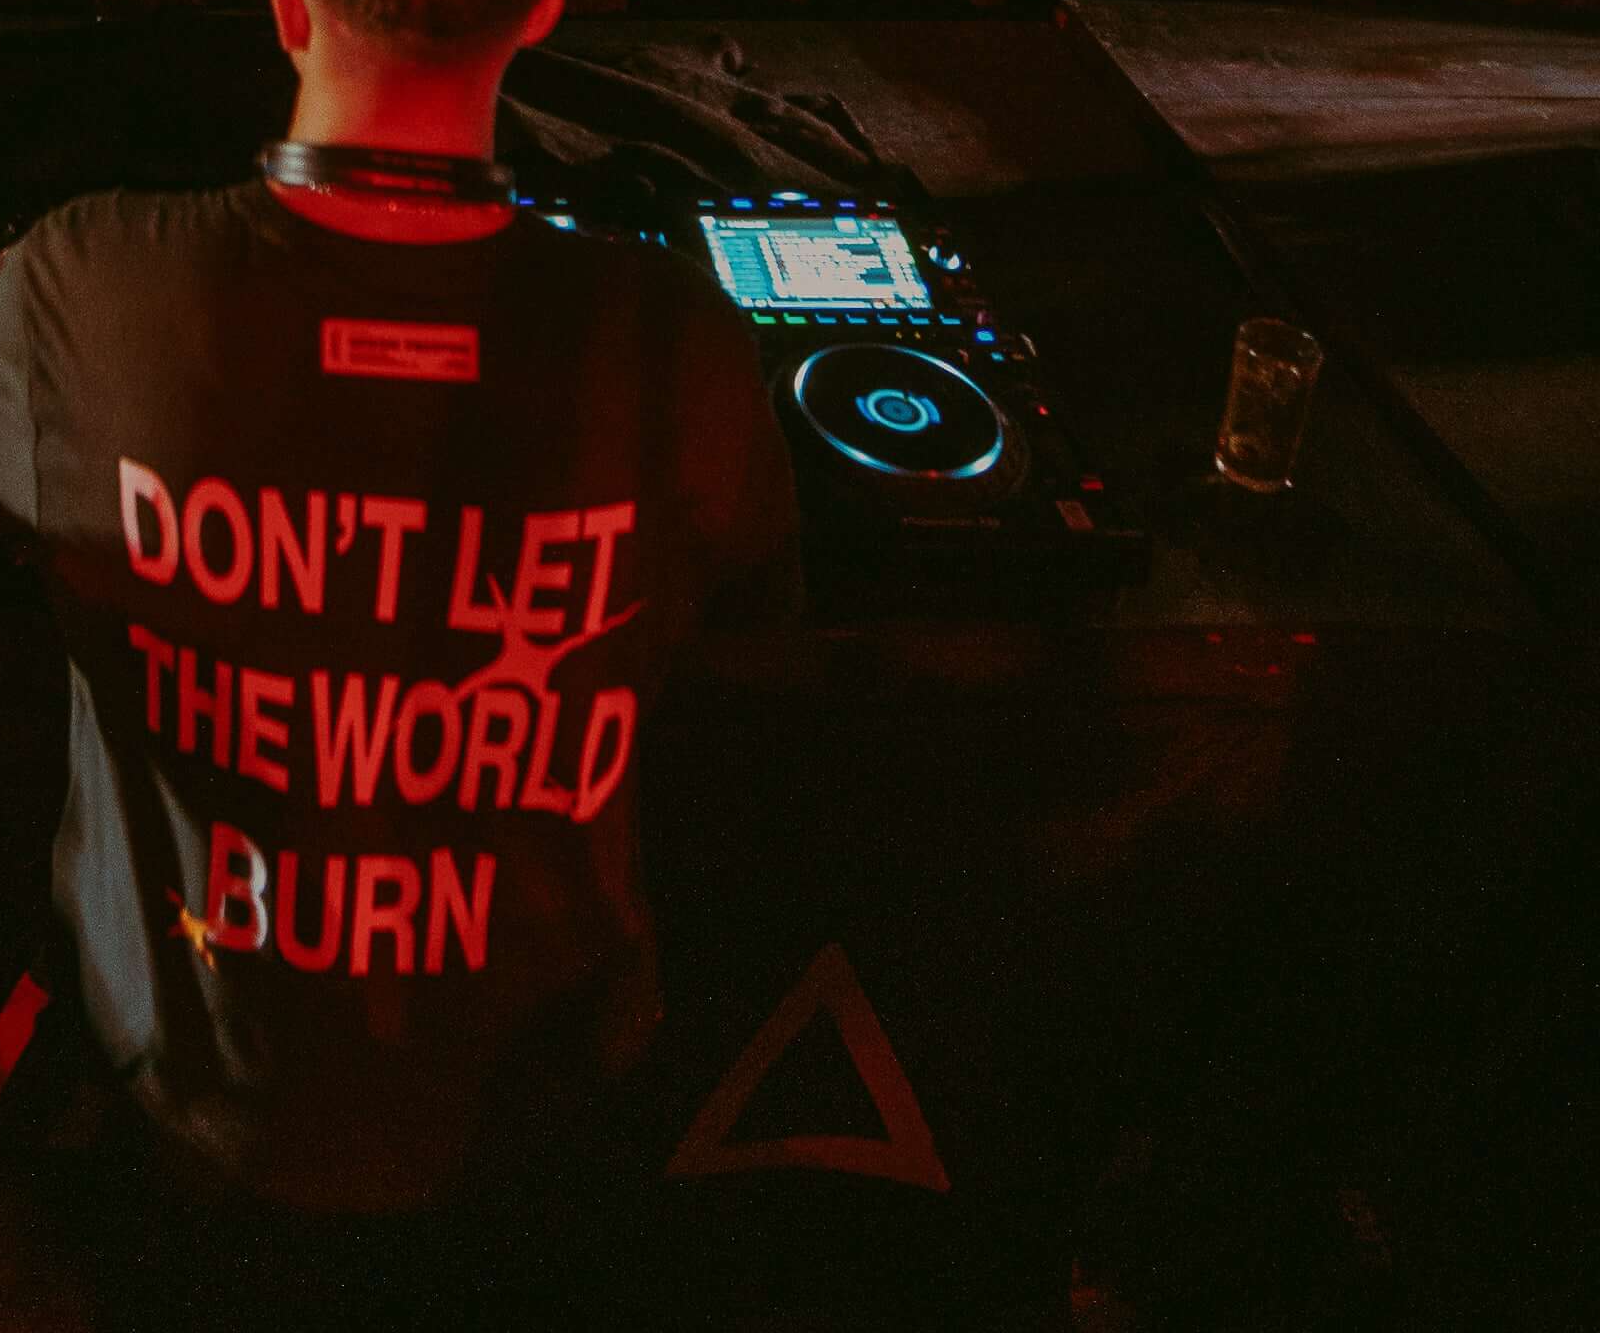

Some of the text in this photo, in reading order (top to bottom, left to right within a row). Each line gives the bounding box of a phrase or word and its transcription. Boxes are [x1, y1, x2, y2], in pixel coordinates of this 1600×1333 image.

[118, 455, 637, 635] DON'T LET
[127, 624, 639, 824] THE WORLD
[204, 822, 498, 978] BURN
